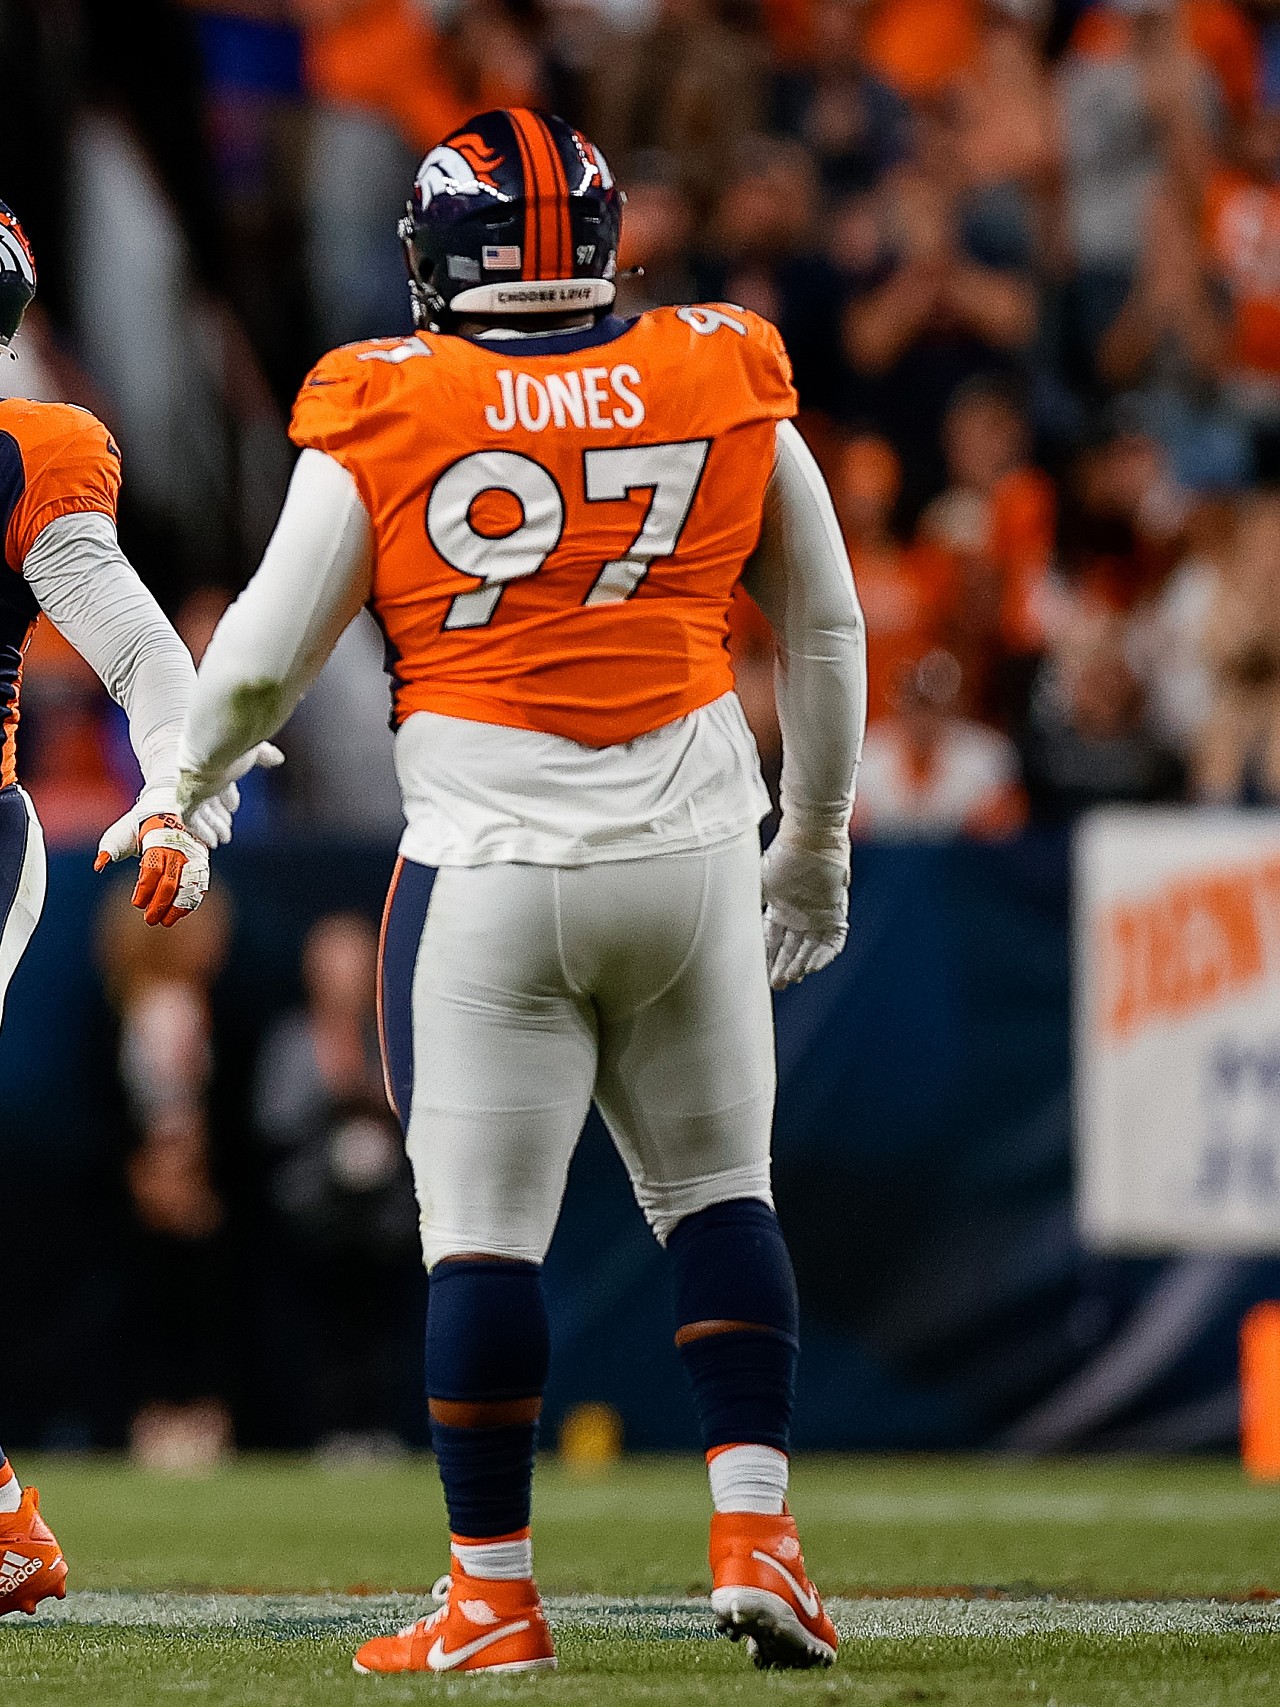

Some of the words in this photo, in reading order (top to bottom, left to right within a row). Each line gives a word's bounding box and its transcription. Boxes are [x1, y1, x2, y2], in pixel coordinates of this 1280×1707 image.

[576, 244, 596, 265] 97
[484, 363, 646, 432] JONES
[426, 437, 714, 632] 97
